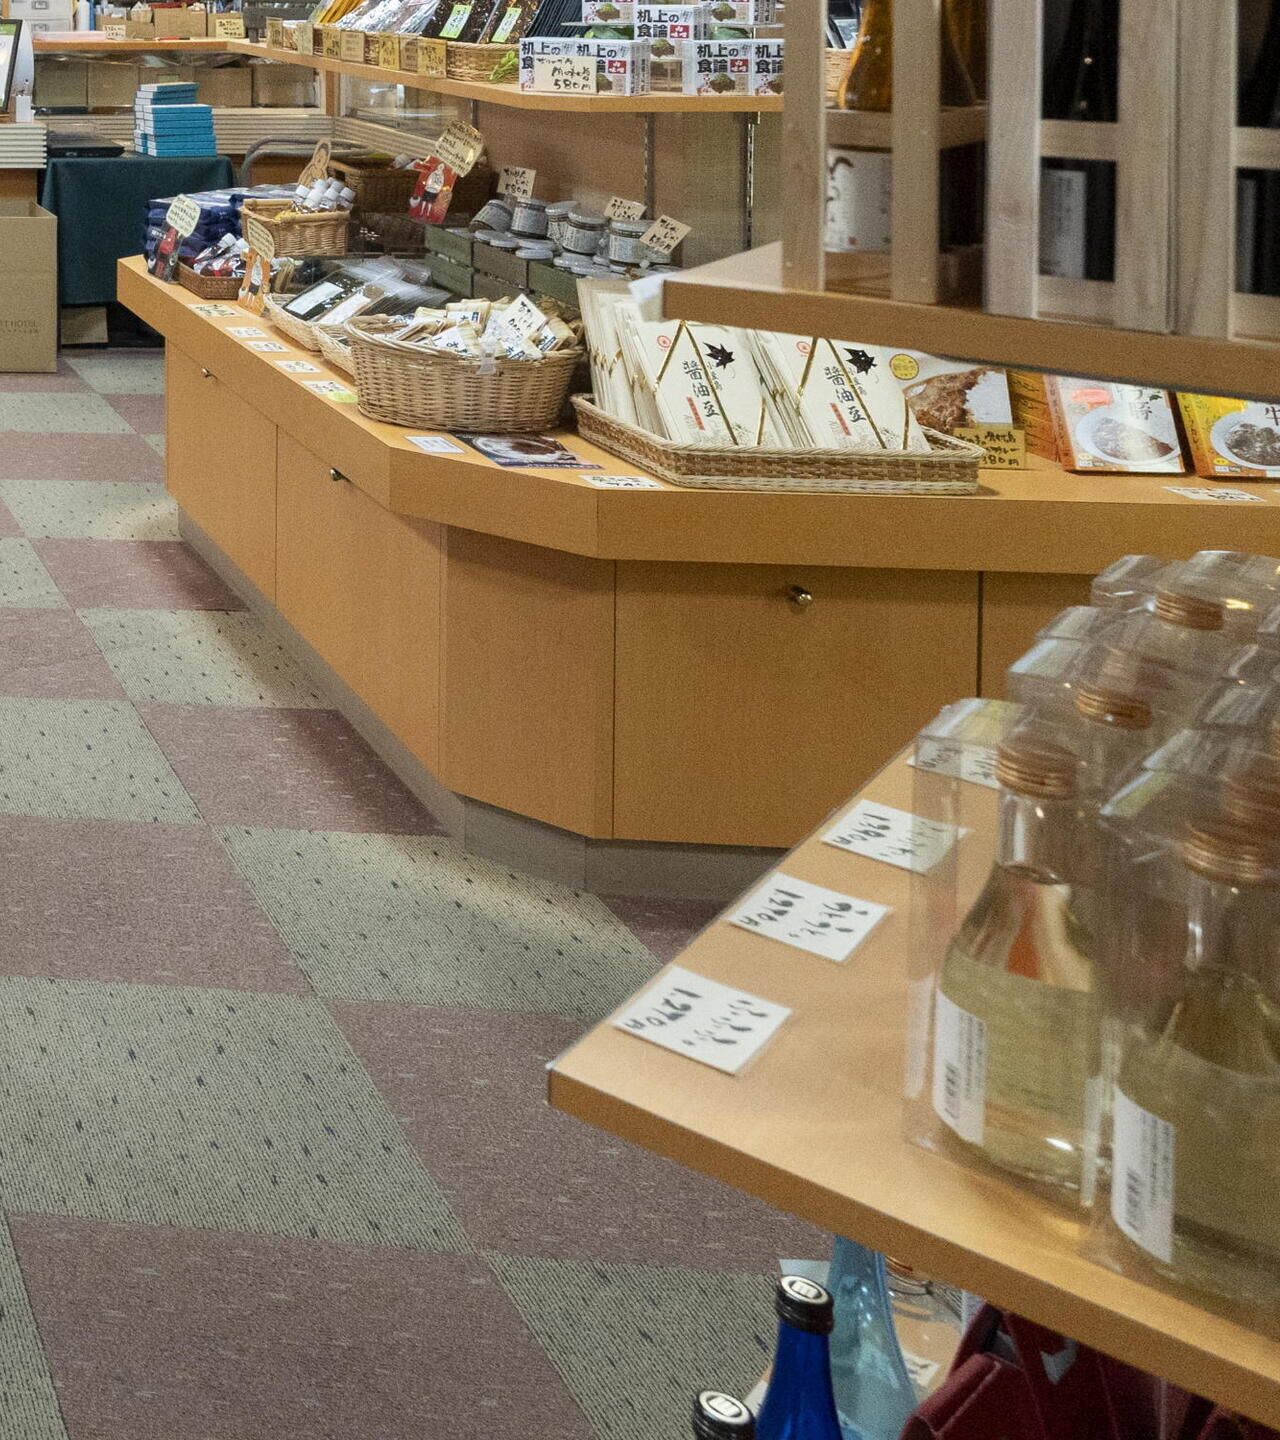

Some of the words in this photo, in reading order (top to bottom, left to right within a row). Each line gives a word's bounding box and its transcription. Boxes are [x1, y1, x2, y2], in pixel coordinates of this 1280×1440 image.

[637, 9, 679, 23] 机上の
[637, 25, 668, 38] 食論
[521, 42, 561, 56] 机上の
[577, 44, 617, 58] 机上の
[697, 44, 738, 58] 机上の
[697, 59, 727, 73] 食論
